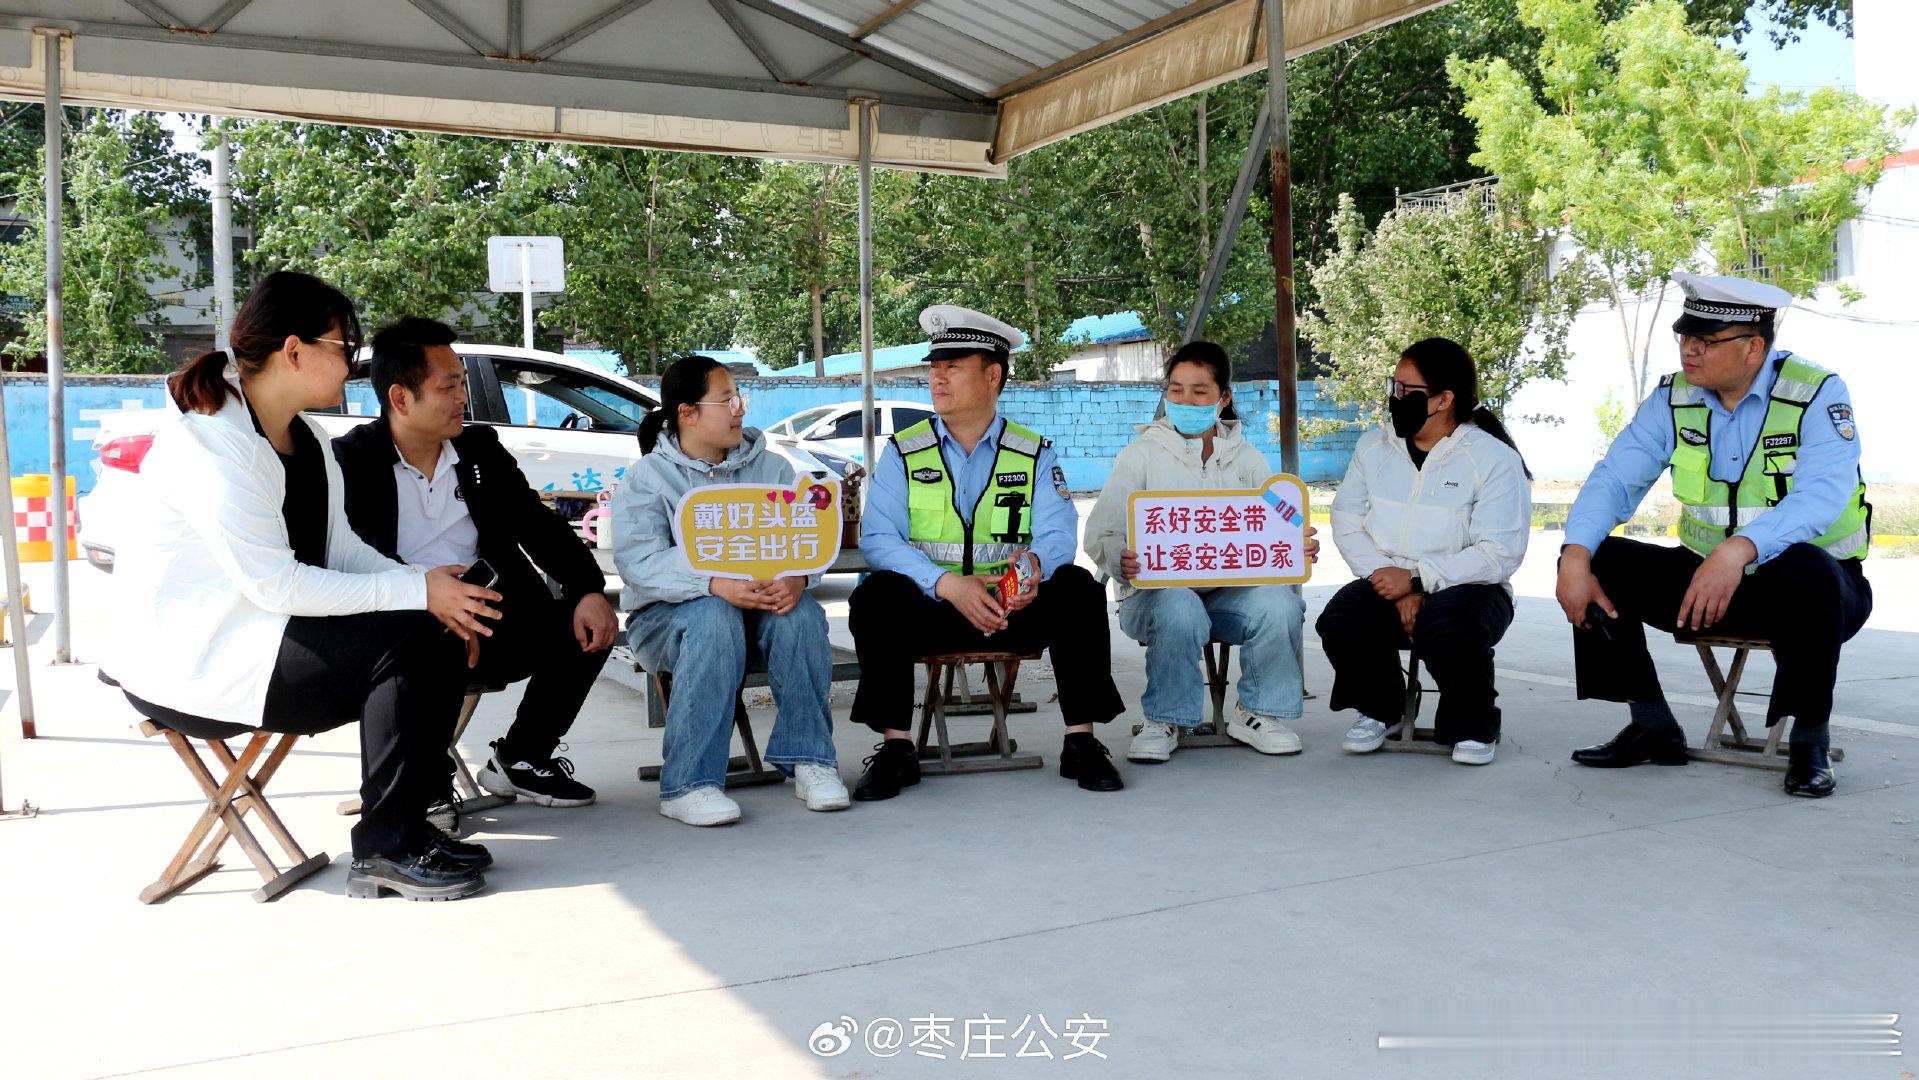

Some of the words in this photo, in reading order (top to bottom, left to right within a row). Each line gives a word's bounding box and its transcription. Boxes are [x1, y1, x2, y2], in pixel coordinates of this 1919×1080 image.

[1765, 437, 1792, 447] FJ2297
[998, 474, 1026, 483] FJ2300
[693, 502, 818, 530] 戴好头盔
[1144, 505, 1267, 535] 系好安全带
[695, 533, 819, 562] 安全出行
[1143, 540, 1293, 572] 让爱安全回家
